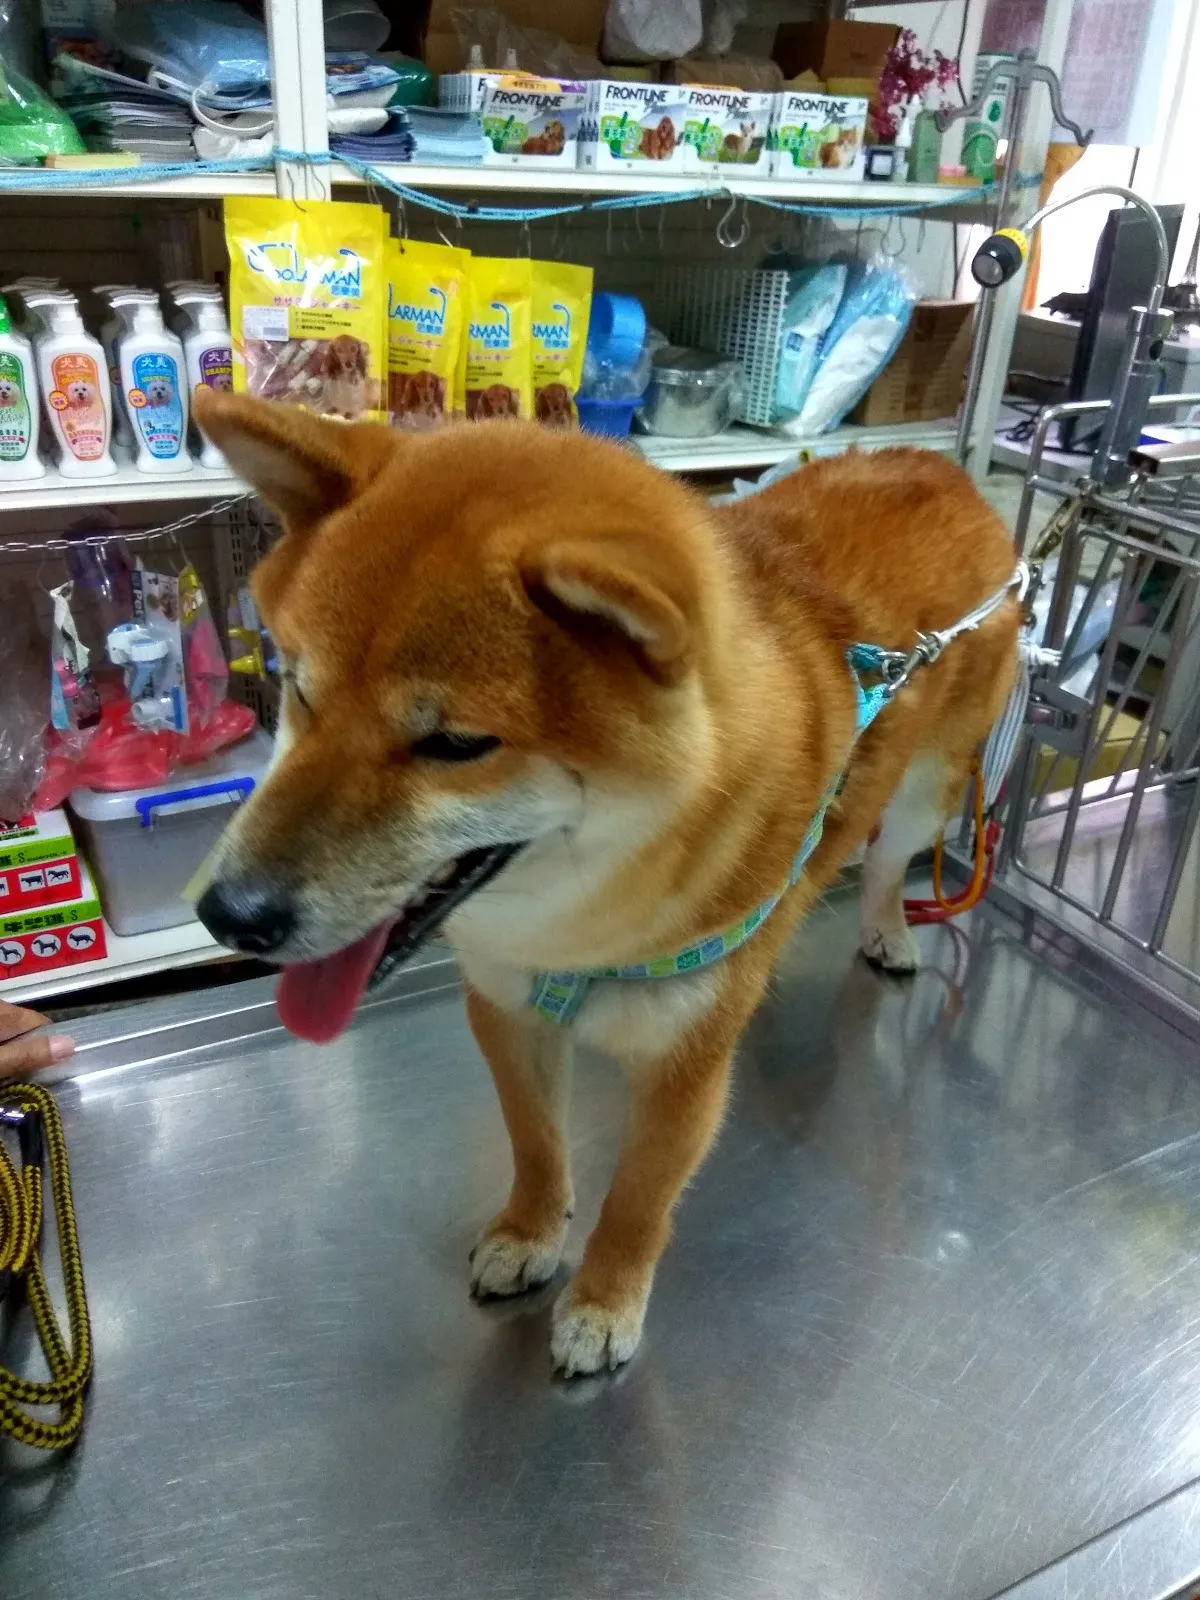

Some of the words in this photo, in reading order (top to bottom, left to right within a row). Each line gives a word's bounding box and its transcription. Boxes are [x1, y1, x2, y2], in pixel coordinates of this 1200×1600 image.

[491, 91, 565, 107] FRONTLINE
[605, 85, 669, 102] FRONTLINE
[688, 92, 752, 109] FRONTLINE
[788, 97, 850, 113] FRONTLINE
